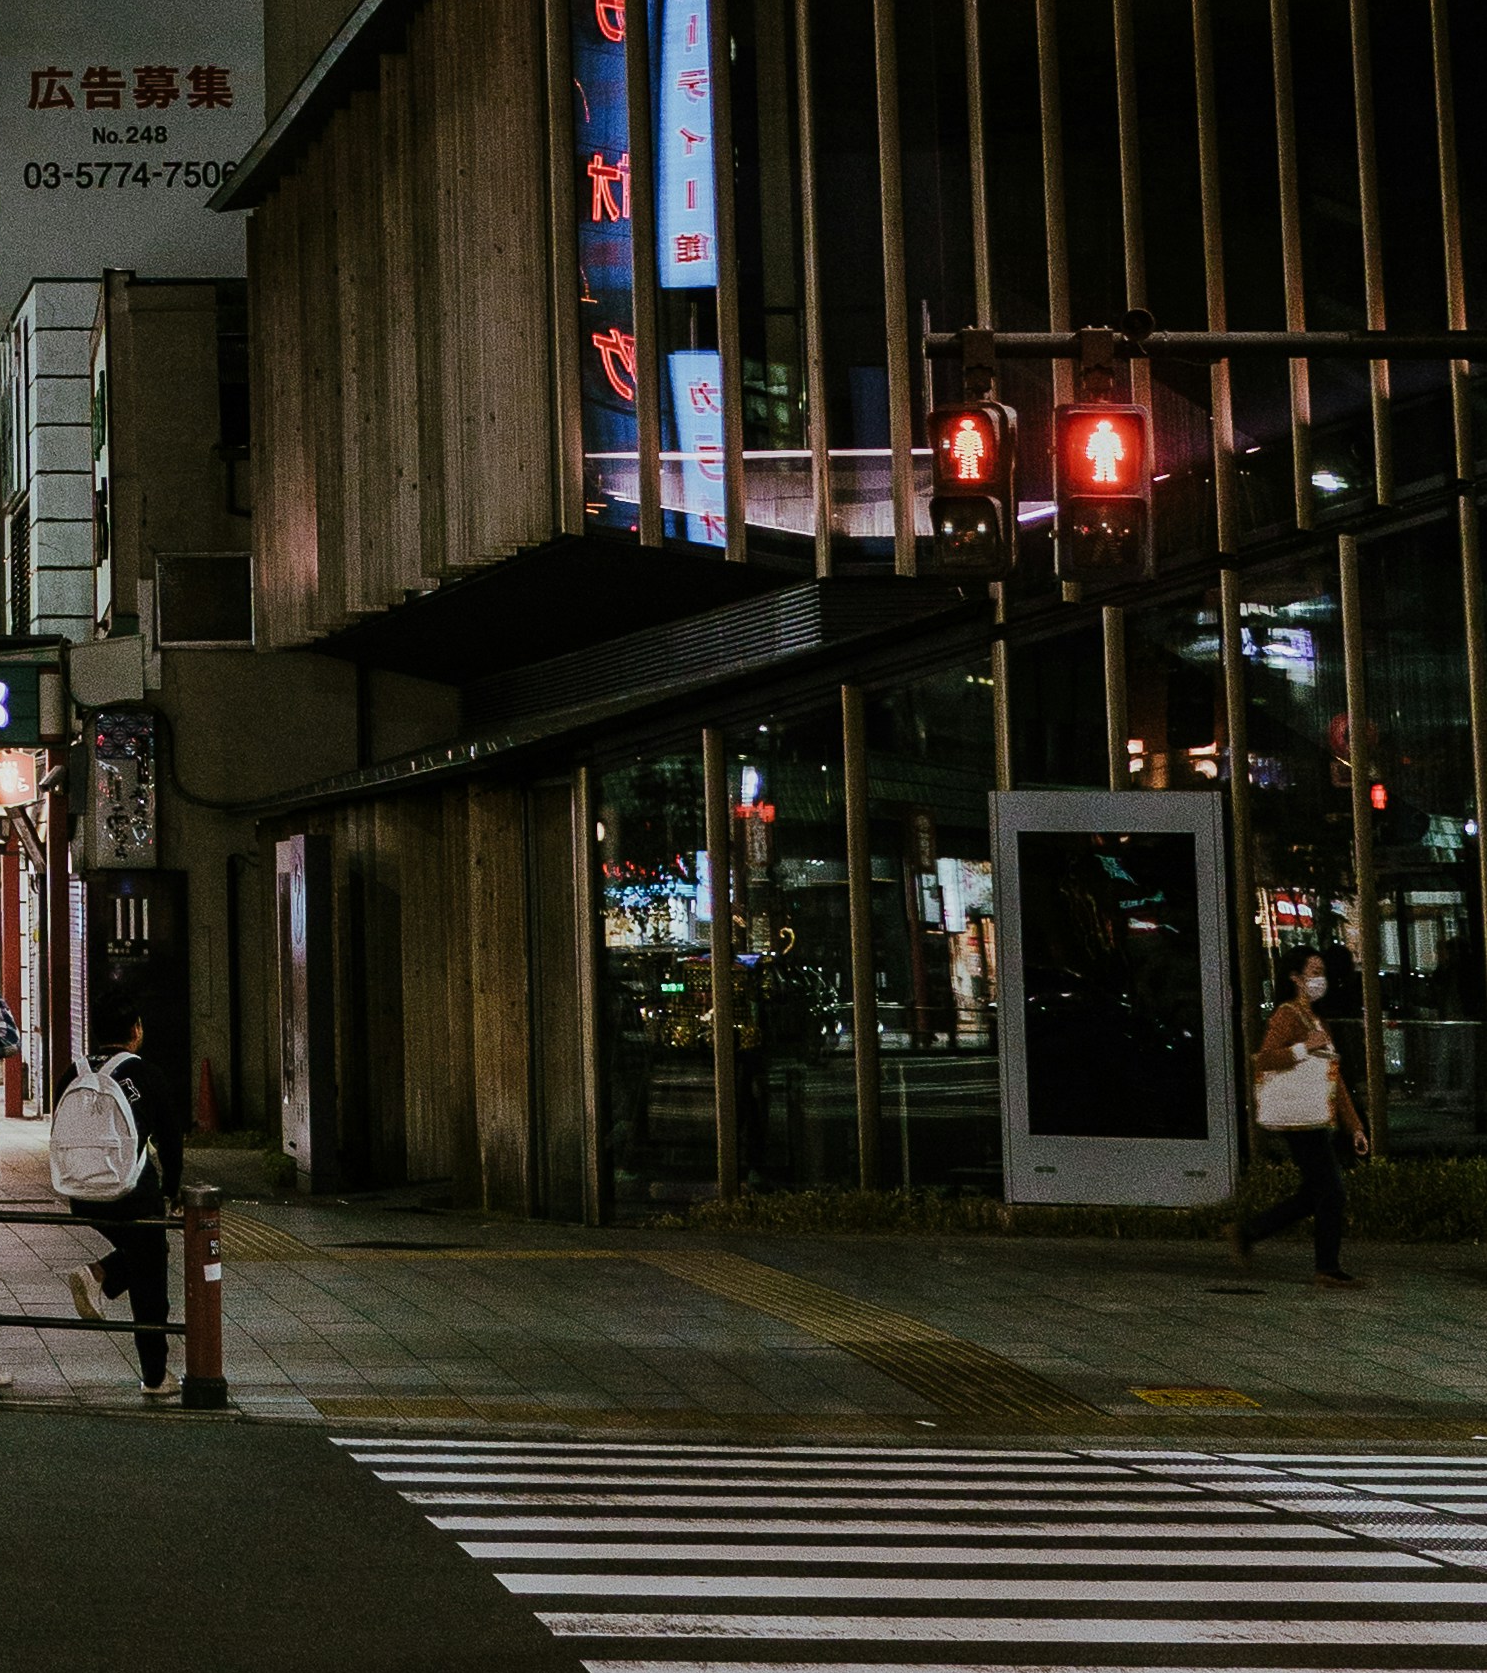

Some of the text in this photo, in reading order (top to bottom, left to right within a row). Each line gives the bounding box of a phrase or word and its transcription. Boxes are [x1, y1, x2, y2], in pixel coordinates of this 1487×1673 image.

[28, 65, 234, 110] 広告募集
[92, 126, 168, 144] No.248
